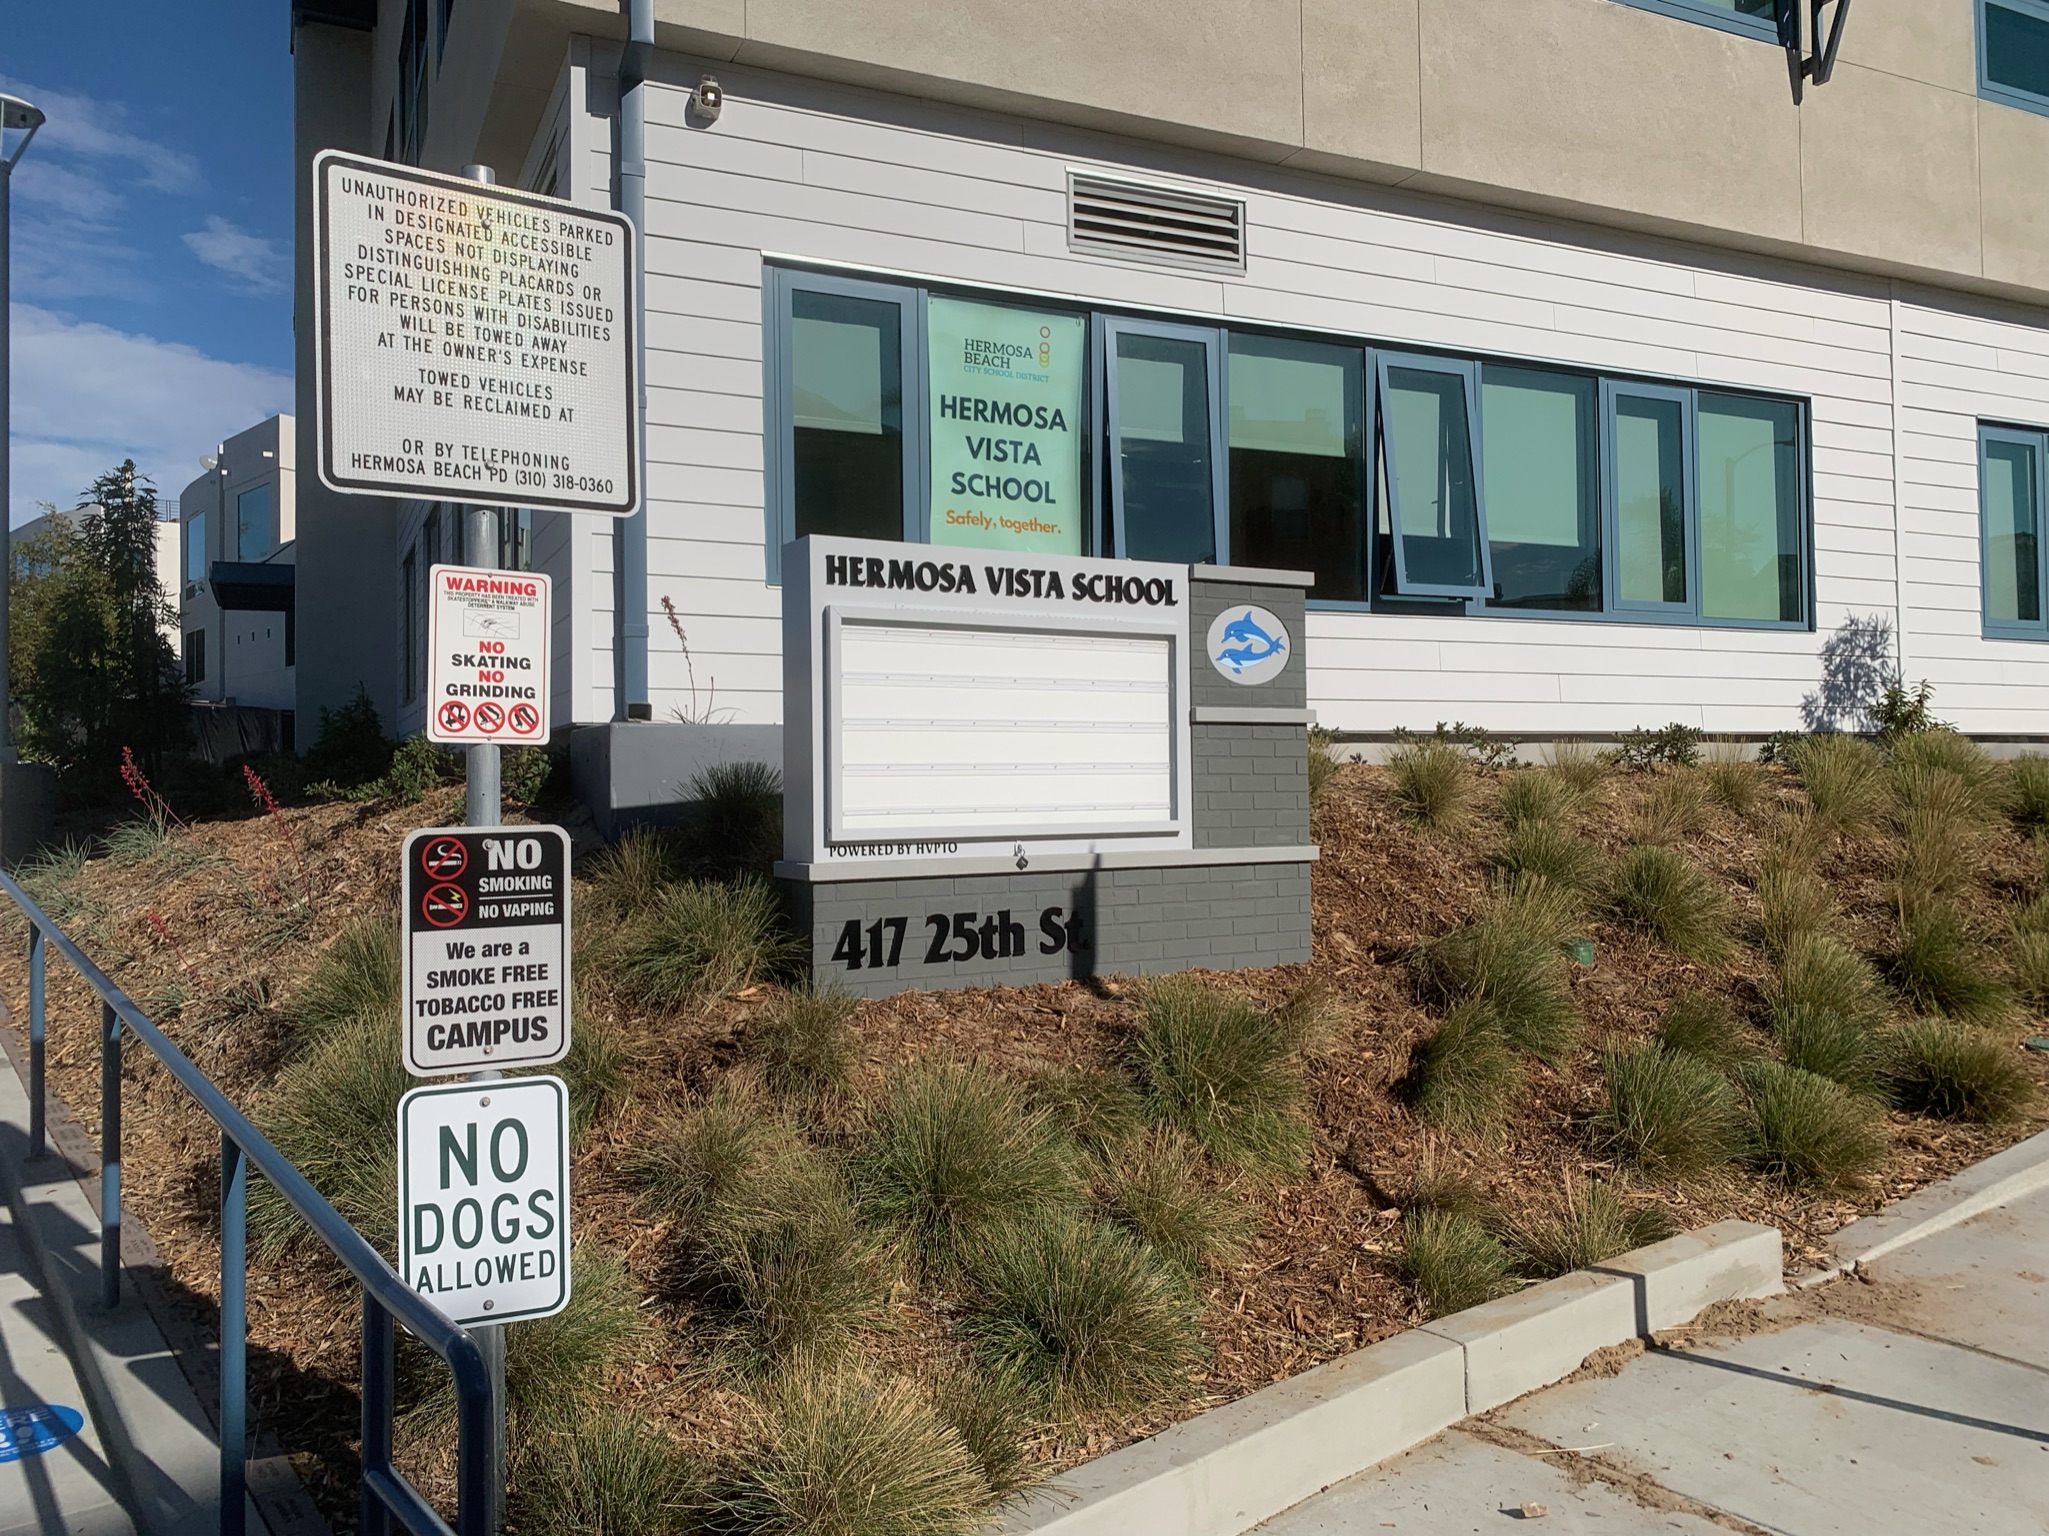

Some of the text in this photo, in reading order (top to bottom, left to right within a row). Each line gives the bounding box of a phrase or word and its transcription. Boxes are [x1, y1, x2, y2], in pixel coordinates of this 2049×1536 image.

[342, 178, 613, 246] UNAUTHORIZED VEHICLES PARKED
[368, 203, 592, 261] IN DESIGNATED ACCESSIBLE
[385, 229, 579, 278] SPACES NOT DISPLAYING
[358, 244, 601, 302] DISTINGUISHING PLACARDS OR
[344, 263, 613, 322] SPECIAL LICENSE PLATES ISSUED
[348, 285, 611, 342] FOR PERSONS WITH DISABILITIES
[400, 314, 568, 354] WILL BE TOWED AWAY
[964, 338, 1033, 359] HERMOSA
[378, 332, 588, 377] AT THE OWNER'S EXPENSE
[964, 352, 1011, 370] BEACH
[418, 368, 552, 400] TOWED VEHICLES
[963, 365, 1049, 383] CITY SCHOOL DISTRICT
[394, 386, 574, 423] MAY BE RECLAIMED AT
[940, 394, 1068, 432] HERMOSA
[402, 438, 570, 471] OR BY TELEPHONING
[965, 435, 1042, 466] VISTA
[351, 452, 613, 494] HERMOSA BEACH PD (310) 318-0360
[950, 471, 1056, 504] SCHOOL
[946, 509, 1062, 534] Safely, together.
[446, 577, 536, 596] WARNING
[825, 554, 1178, 606] HERMOSA VISTA SCHOOL
[451, 653, 532, 670] SKATING
[479, 641, 505, 654] NO
[445, 683, 536, 699] GRINDING
[478, 670, 505, 683] NO
[487, 838, 543, 871] NO
[829, 841, 957, 857] POWERED BY HVPTO
[478, 875, 552, 893] SMOKING
[478, 901, 554, 919] NO VAPING
[446, 940, 530, 960] We are a
[830, 906, 1091, 971] 417 25th St.
[427, 963, 549, 989] SMOKE FREE
[416, 989, 558, 1017] TOBACCO FREE
[427, 1016, 549, 1051] CAMPUS
[439, 1117, 529, 1190] NO
[414, 1189, 555, 1256] DOGS
[416, 1249, 555, 1294] ALLOWED
